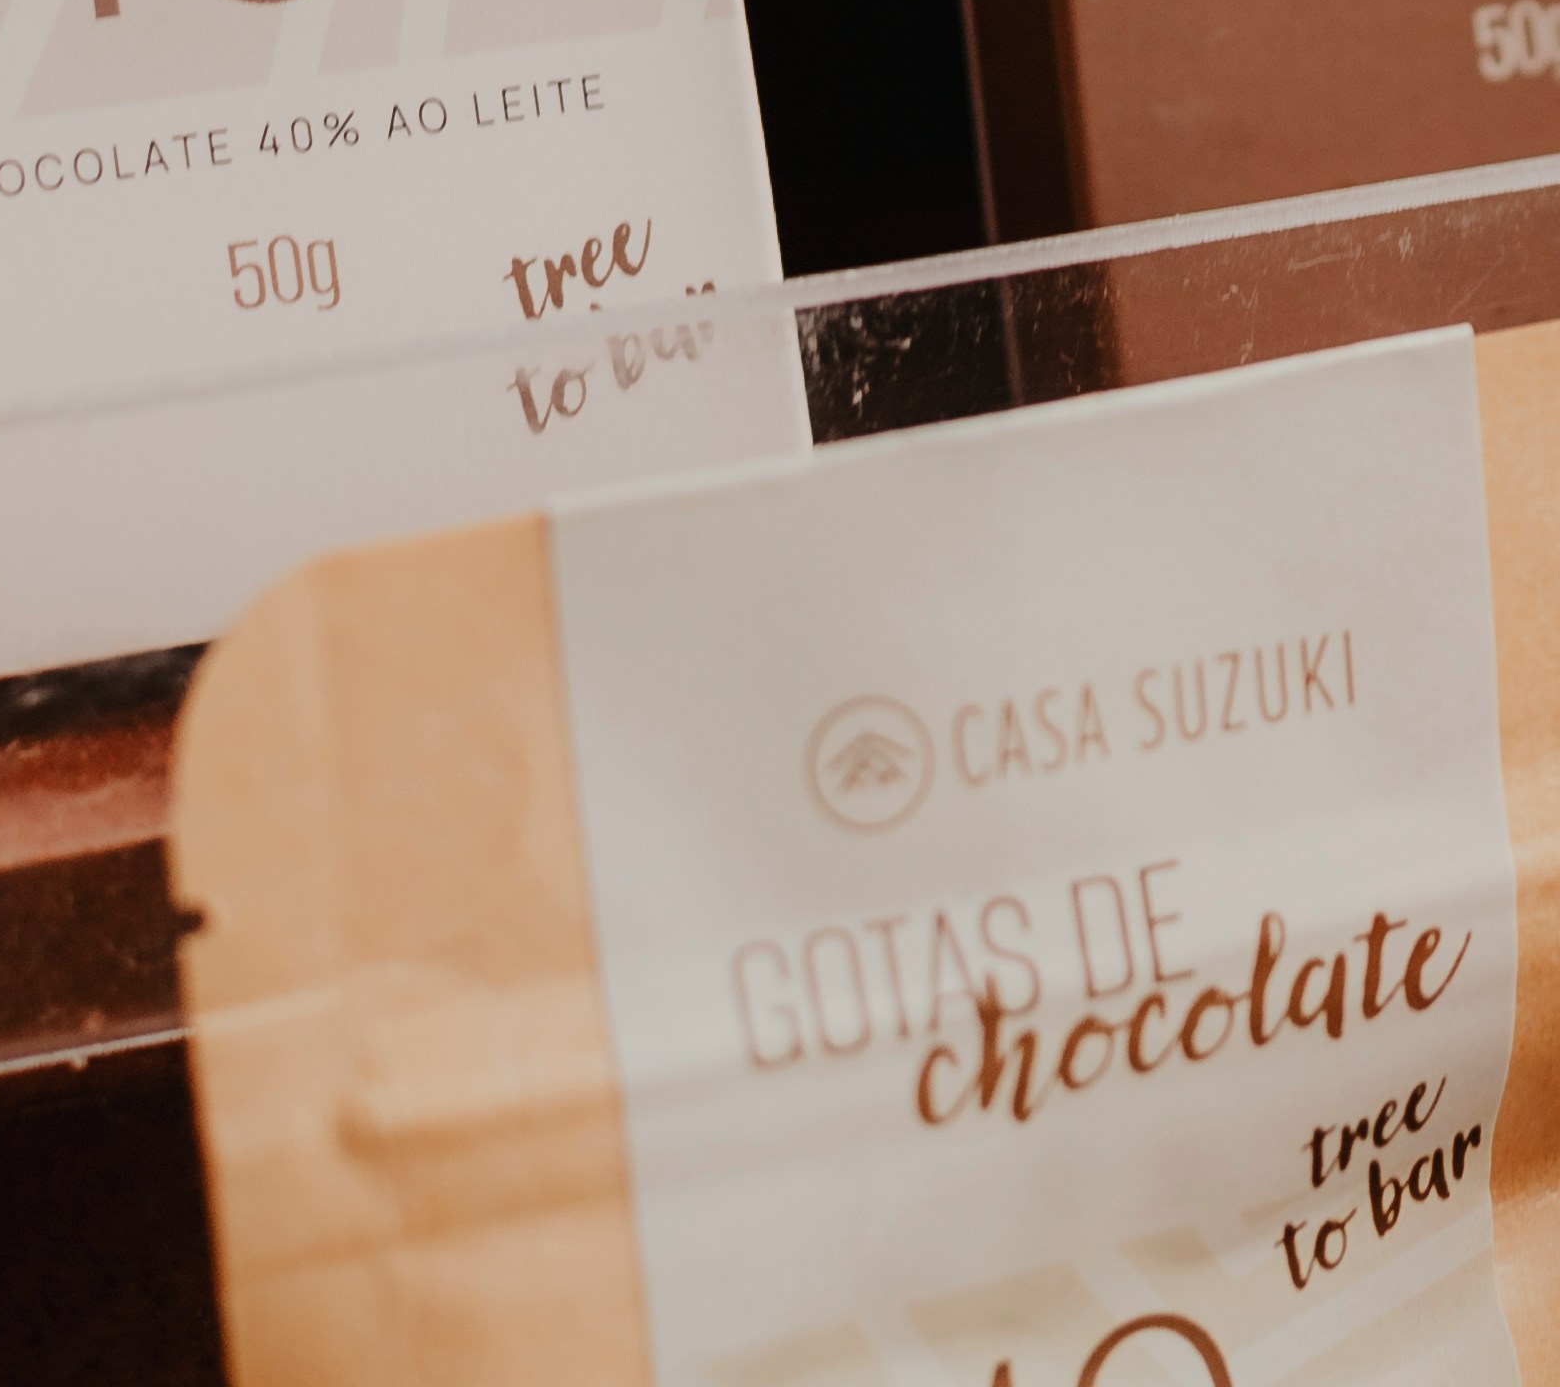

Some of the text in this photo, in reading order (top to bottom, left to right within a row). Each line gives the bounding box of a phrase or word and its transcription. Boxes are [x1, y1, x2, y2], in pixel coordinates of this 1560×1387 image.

[259, 112, 360, 154] 40%
[388, 98, 448, 137] AO
[474, 73, 606, 127] LEITE
[228, 235, 340, 311] 50g
[503, 218, 651, 318] tree
[507, 359, 596, 433] to
[952, 629, 1357, 788] CASA SUZUKI
[731, 860, 1197, 1071] GOTAS DE
[915, 912, 1471, 1126] chocolate
[1301, 1076, 1446, 1188] tree
[1275, 1121, 1482, 1290] to bar
